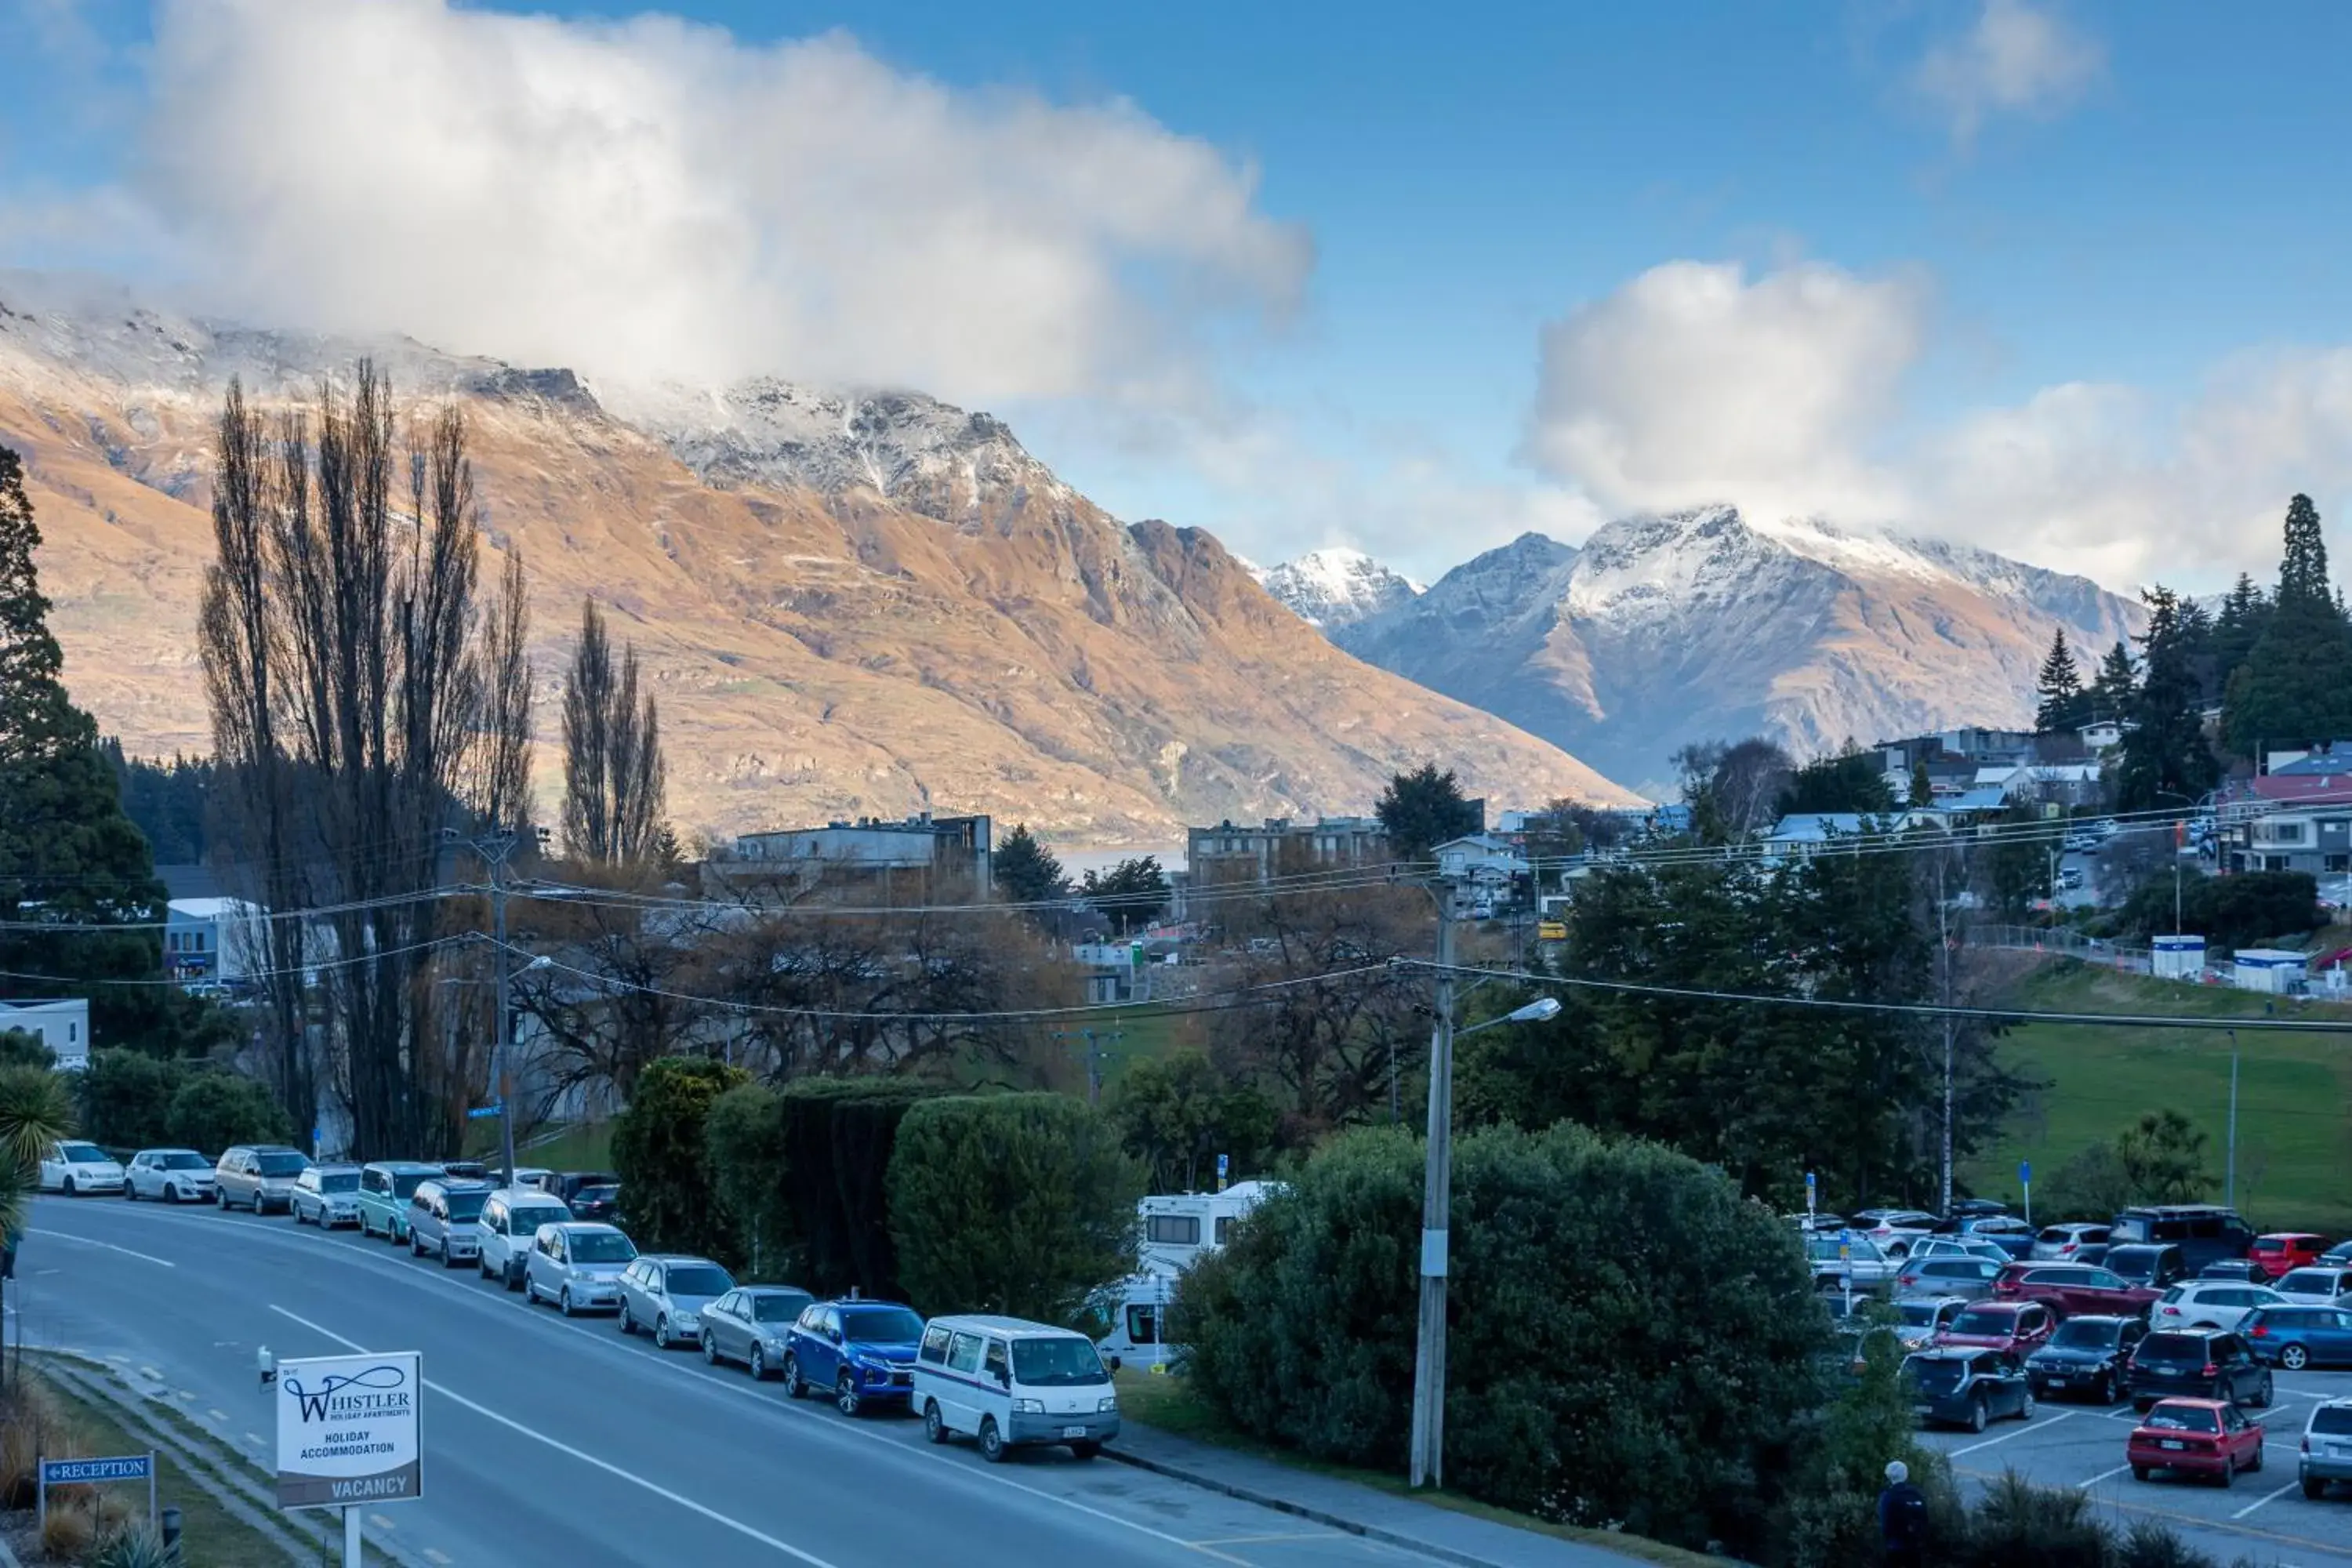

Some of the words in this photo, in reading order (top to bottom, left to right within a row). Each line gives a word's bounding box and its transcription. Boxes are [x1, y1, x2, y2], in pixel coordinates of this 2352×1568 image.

[285, 1367, 410, 1423] WHISTLER
[330, 1412, 361, 1421] HOLIDAY
[364, 1409, 410, 1419] APARTMENTS
[325, 1431, 370, 1443] HOLIDAY
[300, 1442, 394, 1459] ACCOMMODATION
[61, 1461, 144, 1478] RECEPTION
[332, 1475, 407, 1497] VACANCY
